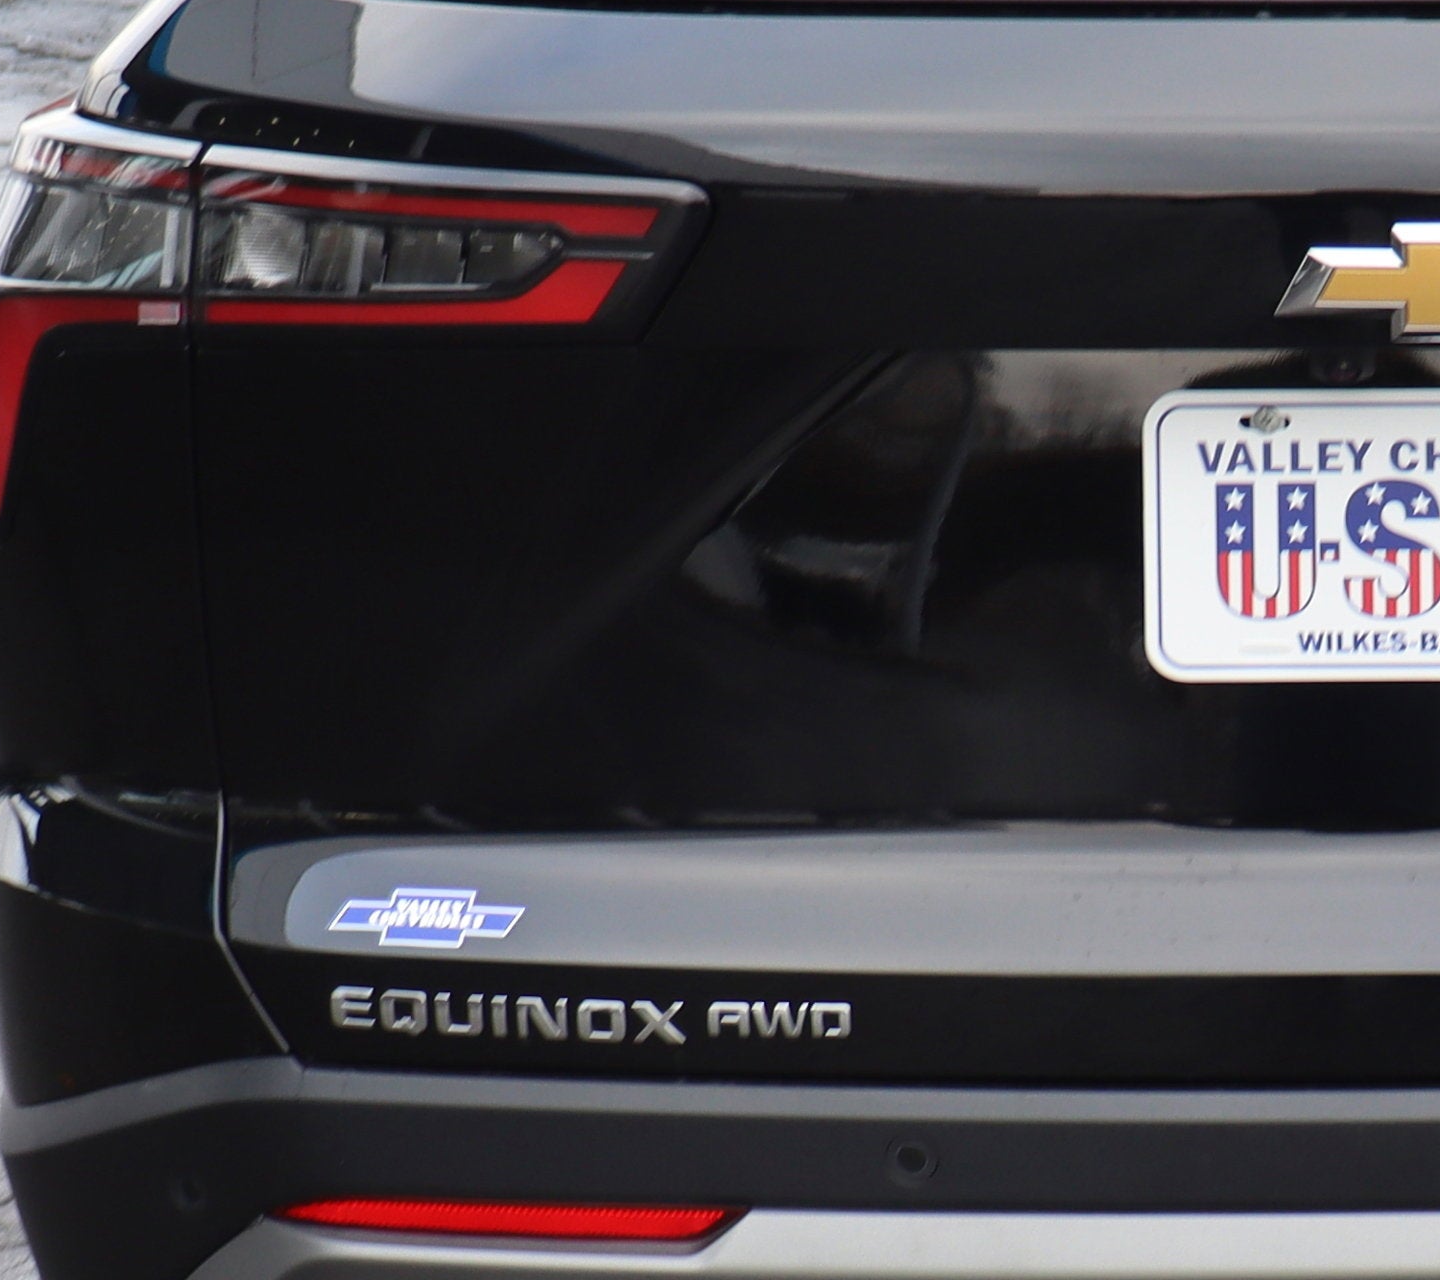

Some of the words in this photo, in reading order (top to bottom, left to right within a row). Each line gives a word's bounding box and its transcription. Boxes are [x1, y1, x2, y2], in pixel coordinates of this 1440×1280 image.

[1198, 438, 1373, 474] VALLEY
[330, 984, 687, 1045] EQUINOX
[706, 1000, 853, 1040] AWD
